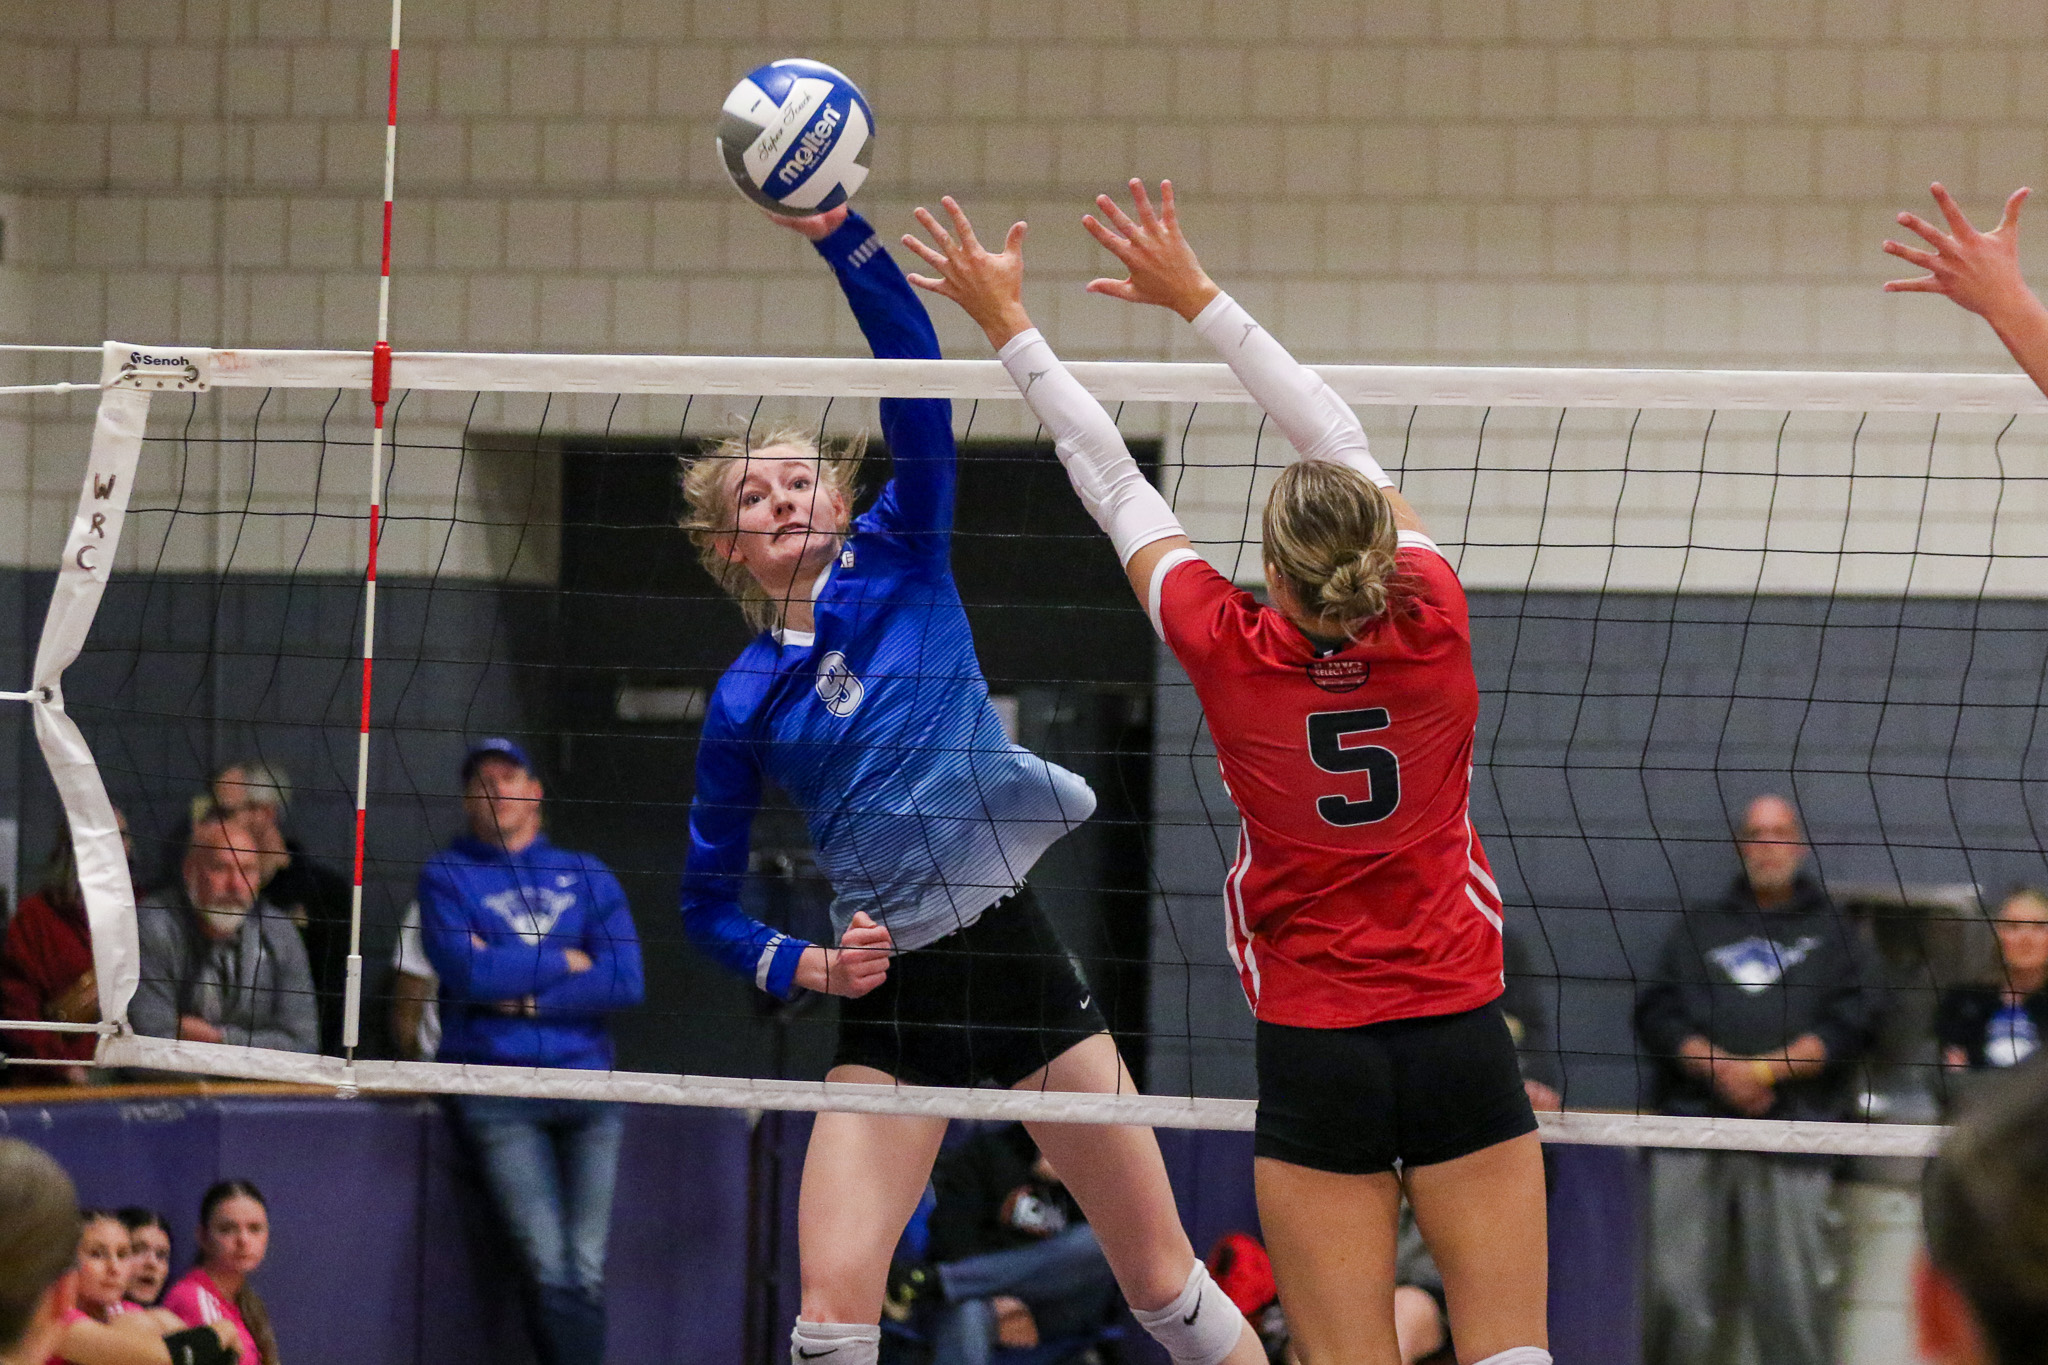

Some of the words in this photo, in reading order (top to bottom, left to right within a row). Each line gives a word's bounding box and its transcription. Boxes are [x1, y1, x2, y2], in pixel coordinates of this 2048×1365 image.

[778, 106, 841, 185] molten
[143, 355, 189, 366] Senoh
[1314, 668, 1343, 676] SELECT
[1306, 706, 1401, 828] 5
